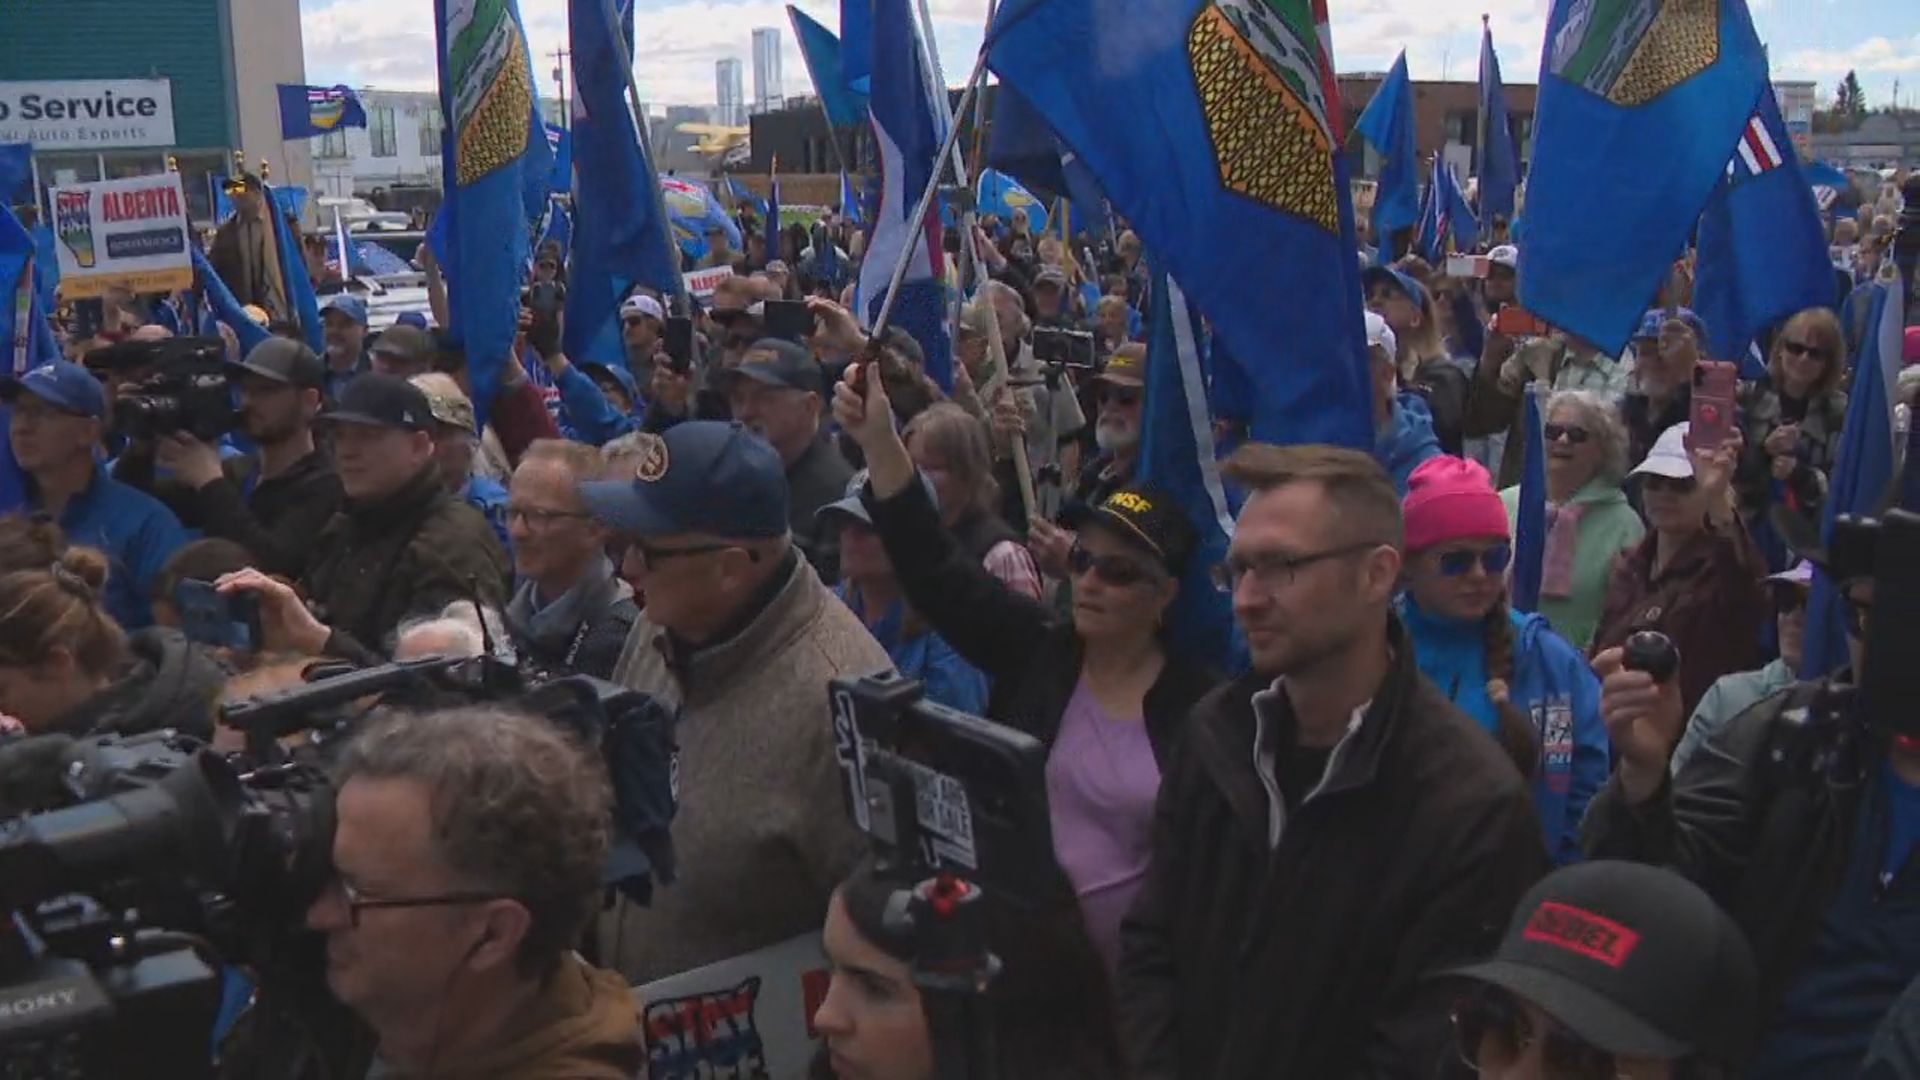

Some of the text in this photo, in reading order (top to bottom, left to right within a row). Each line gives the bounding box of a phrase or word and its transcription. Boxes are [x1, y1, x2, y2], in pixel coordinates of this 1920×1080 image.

[20, 90, 157, 120] Service
[77, 126, 147, 141] Experts
[103, 186, 180, 222] ALBERTA
